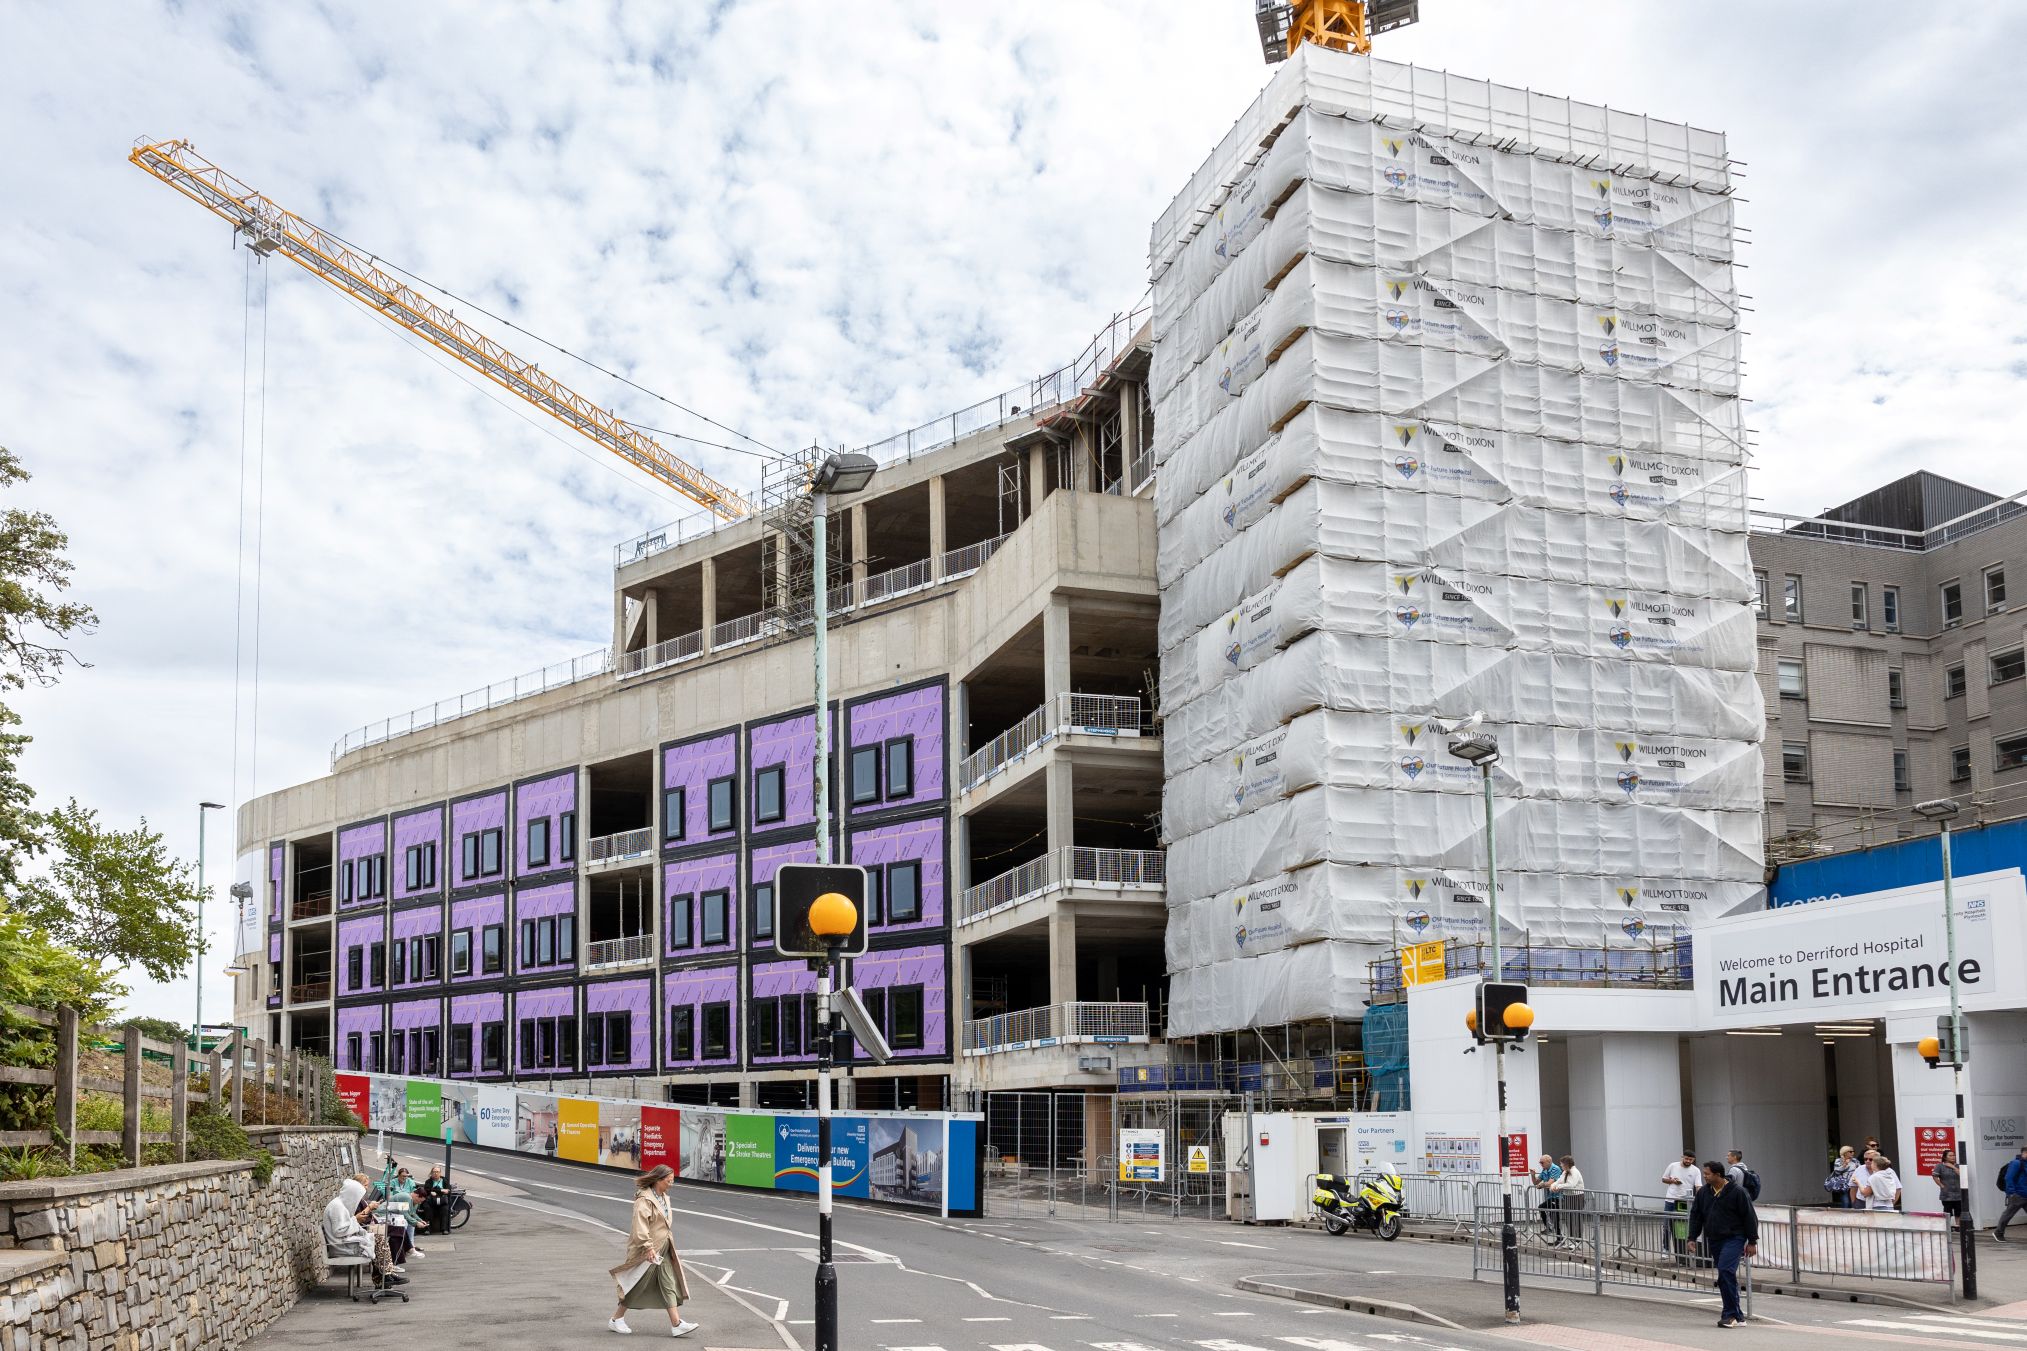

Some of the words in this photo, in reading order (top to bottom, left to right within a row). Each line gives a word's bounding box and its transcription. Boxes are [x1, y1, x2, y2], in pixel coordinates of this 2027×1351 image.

[1452, 150, 1480, 165] DIXON
[1457, 292, 1485, 306] DIXON
[1660, 327, 1687, 341] DIXON
[1466, 436, 1495, 449] DIXON
[1671, 465, 1699, 476] DIXON
[1466, 583, 1494, 595] DIXON
[1630, 601, 1670, 613] WILLMOTT
[1638, 744, 1679, 756] WILLMOTT
[1681, 748, 1707, 759] DIXON
[1425, 761, 1437, 769] Our
[1455, 764, 1478, 773] Hospital
[1476, 881, 1505, 892] DIXN
[1642, 889, 1683, 900] WILLMOTT
[1683, 890, 1708, 900] DIXON
[1968, 900, 1985, 909] NHS
[1431, 916, 1442, 924] Our
[1461, 917, 1484, 926] Hospital
[1425, 946, 1436, 954] LTC
[1720, 955, 1775, 972] Welcome
[1779, 953, 1793, 965] to
[1796, 943, 1859, 963] Derriford
[1863, 934, 1924, 955] Hospital
[1719, 972, 1799, 1007] Main
[1811, 957, 1981, 999] Entrance
[480, 1107, 491, 1120] 60
[492, 1115, 512, 1123] Emergency
[560, 1122, 566, 1134] 4
[644, 1124, 661, 1133] Separate
[1990, 1119, 2016, 1133] M&S
[1984, 1134, 1996, 1142] Open
[2004, 1133, 2025, 1141] business
[644, 1141, 665, 1149] Emergency
[729, 1141, 736, 1157] 2
[736, 1141, 757, 1150] Specialist
[798, 1143, 820, 1154] Deliverin
[837, 1146, 850, 1155] new
[2000, 1140, 2014, 1148] usual
[644, 1149, 667, 1157] Department
[736, 1150, 751, 1158] Stroke
[791, 1154, 820, 1167] Emergency
[832, 1157, 856, 1170] Building
